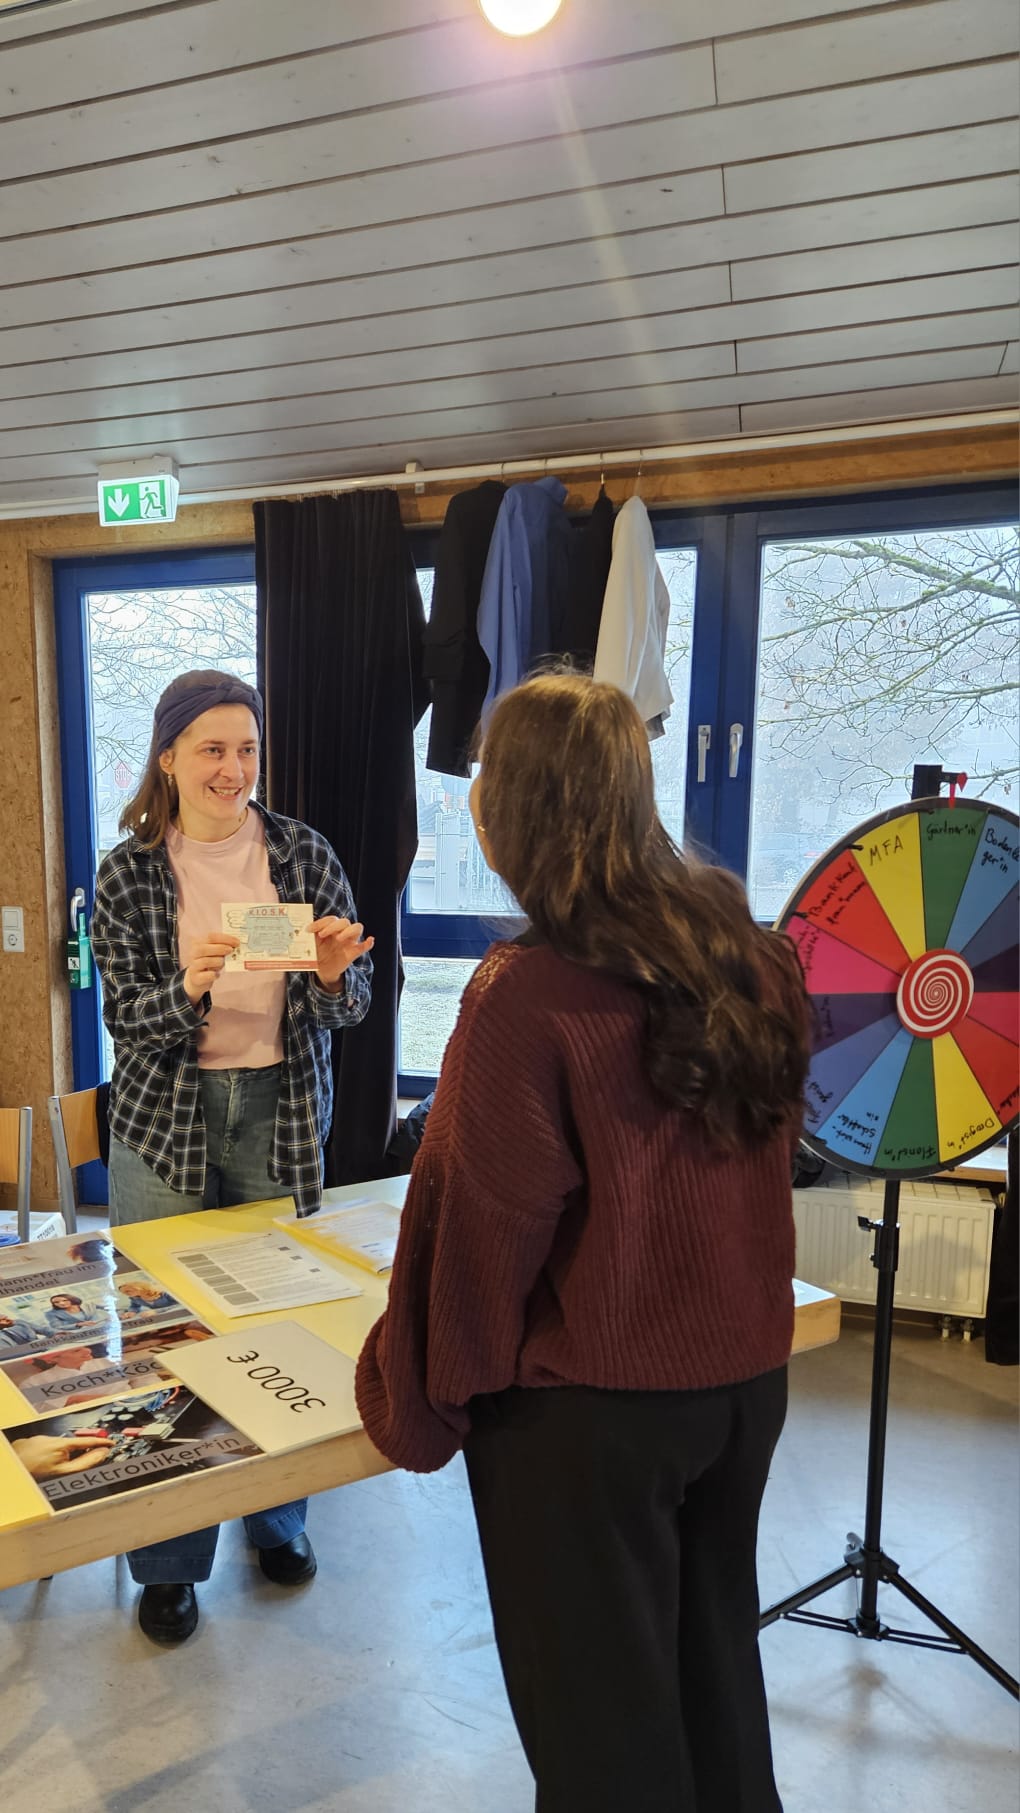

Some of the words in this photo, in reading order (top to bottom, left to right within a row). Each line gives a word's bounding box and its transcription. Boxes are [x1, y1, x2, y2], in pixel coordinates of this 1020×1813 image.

[868, 834, 904, 866] MFA
[226, 1350, 259, 1363] €
[247, 1366, 326, 1413] 3000
